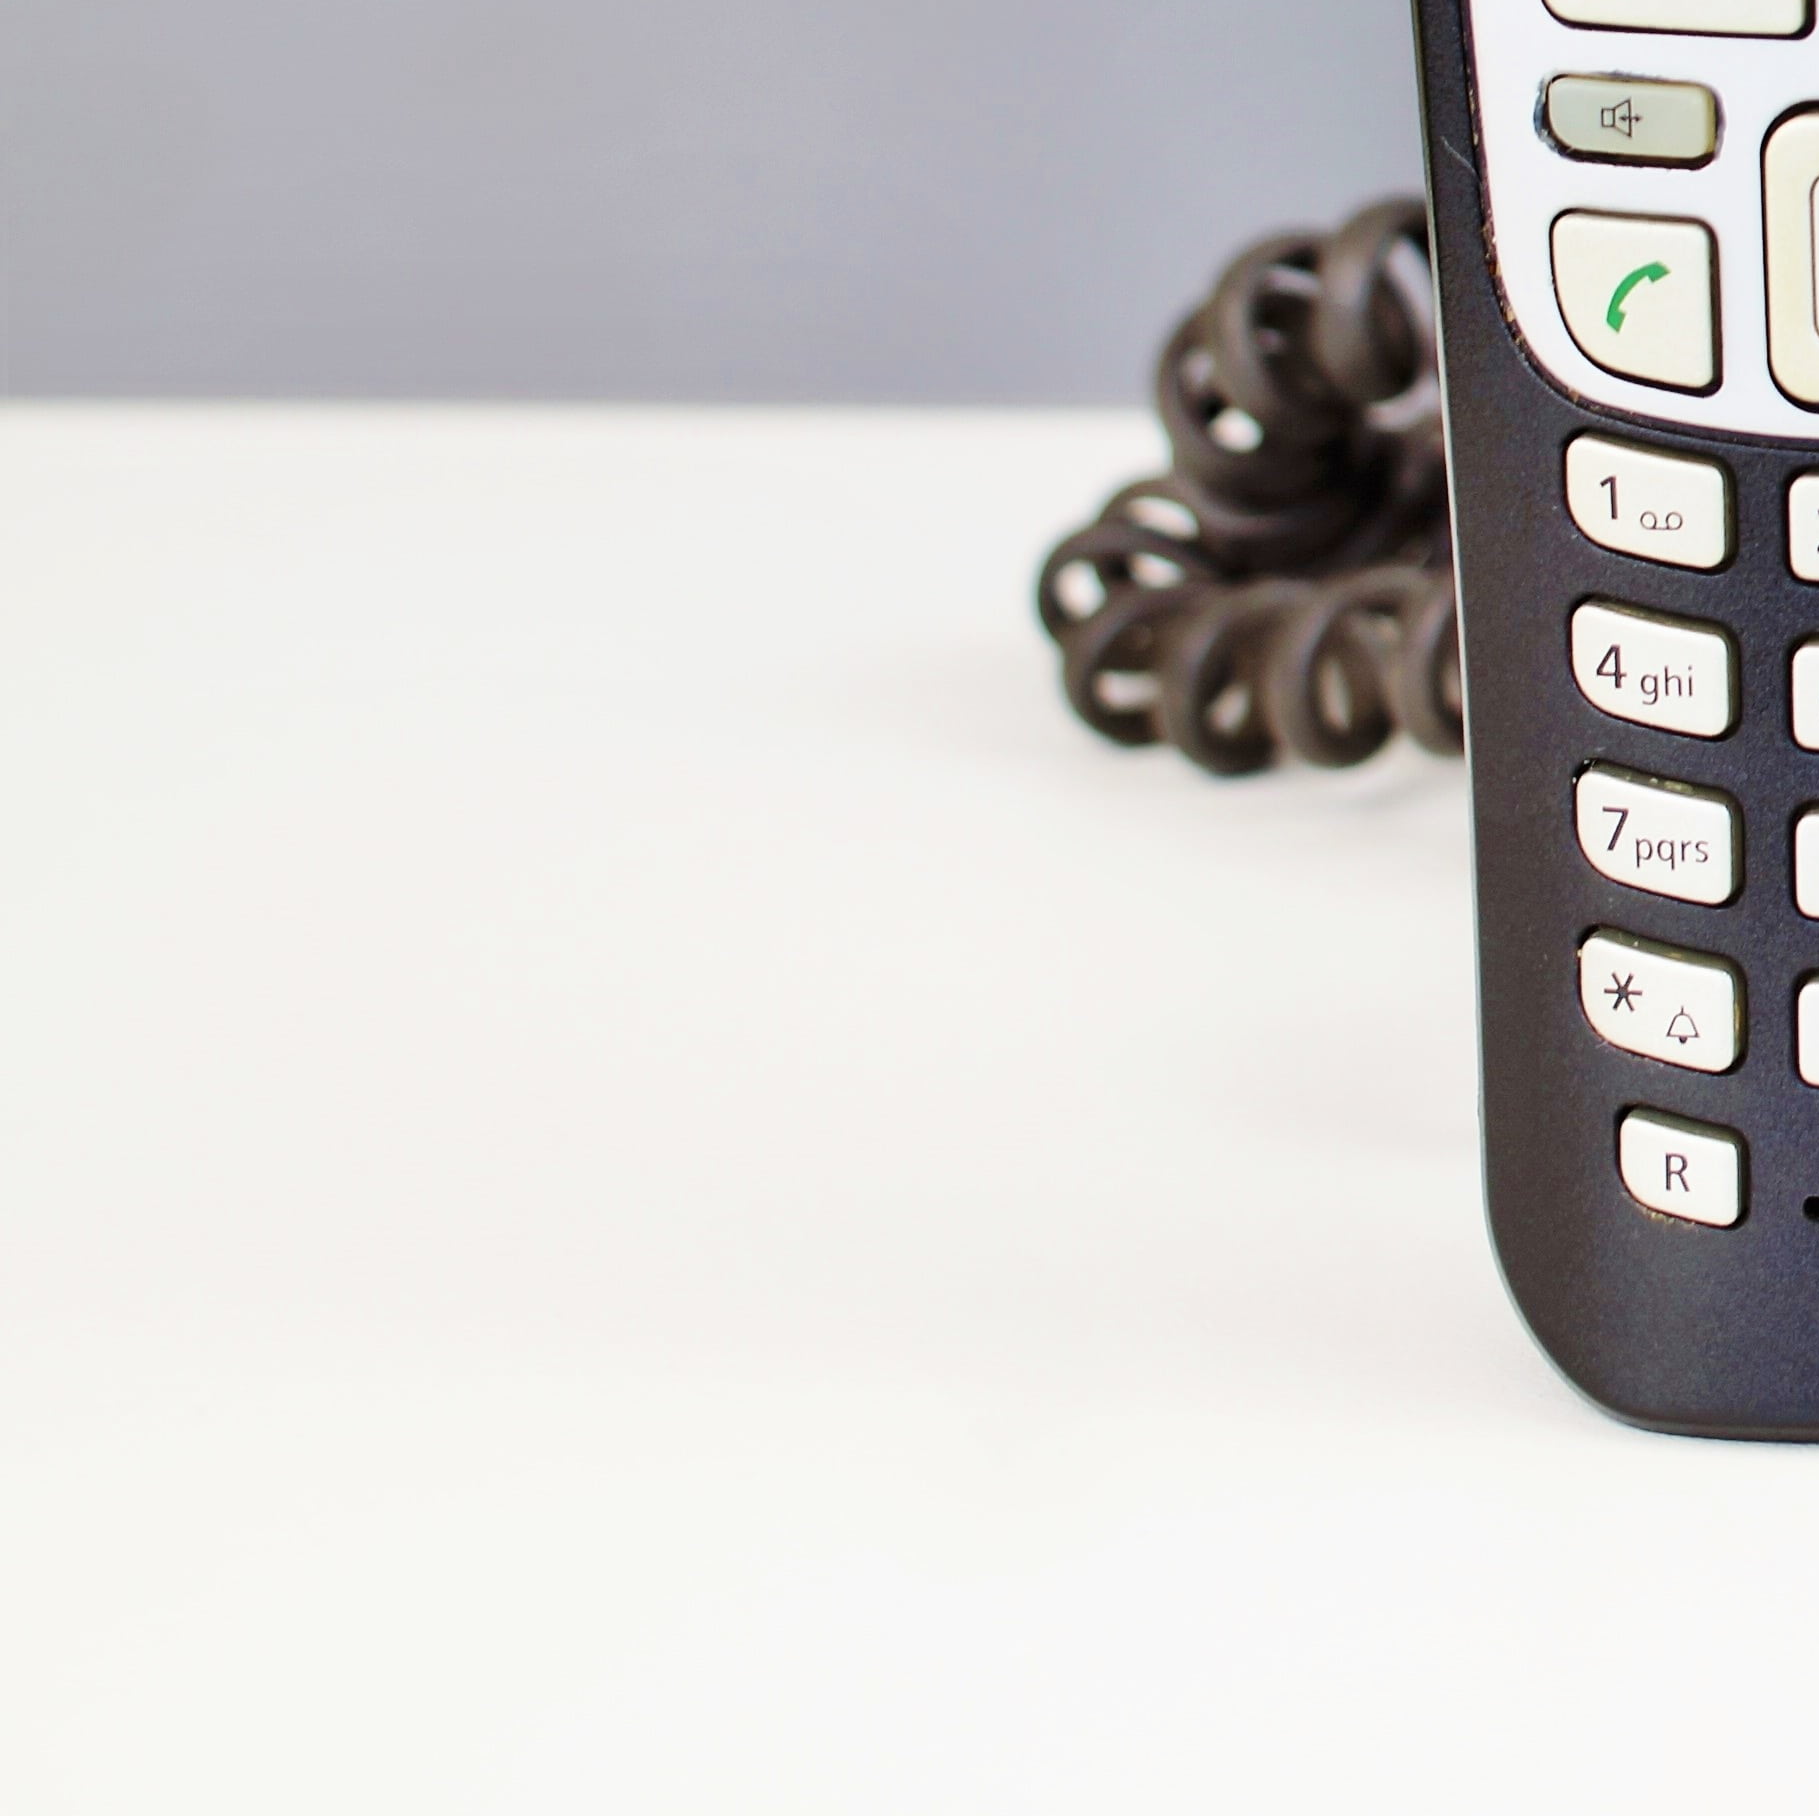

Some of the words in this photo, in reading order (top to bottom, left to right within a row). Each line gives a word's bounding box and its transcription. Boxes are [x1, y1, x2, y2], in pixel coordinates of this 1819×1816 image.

[1600, 475, 1619, 521] 1
[1596, 645, 1627, 689] 4
[1640, 666, 1694, 705] ghi
[1602, 807, 1629, 852] 7
[1634, 837, 1710, 871] pqrs
[1664, 1153, 1690, 1193] R
